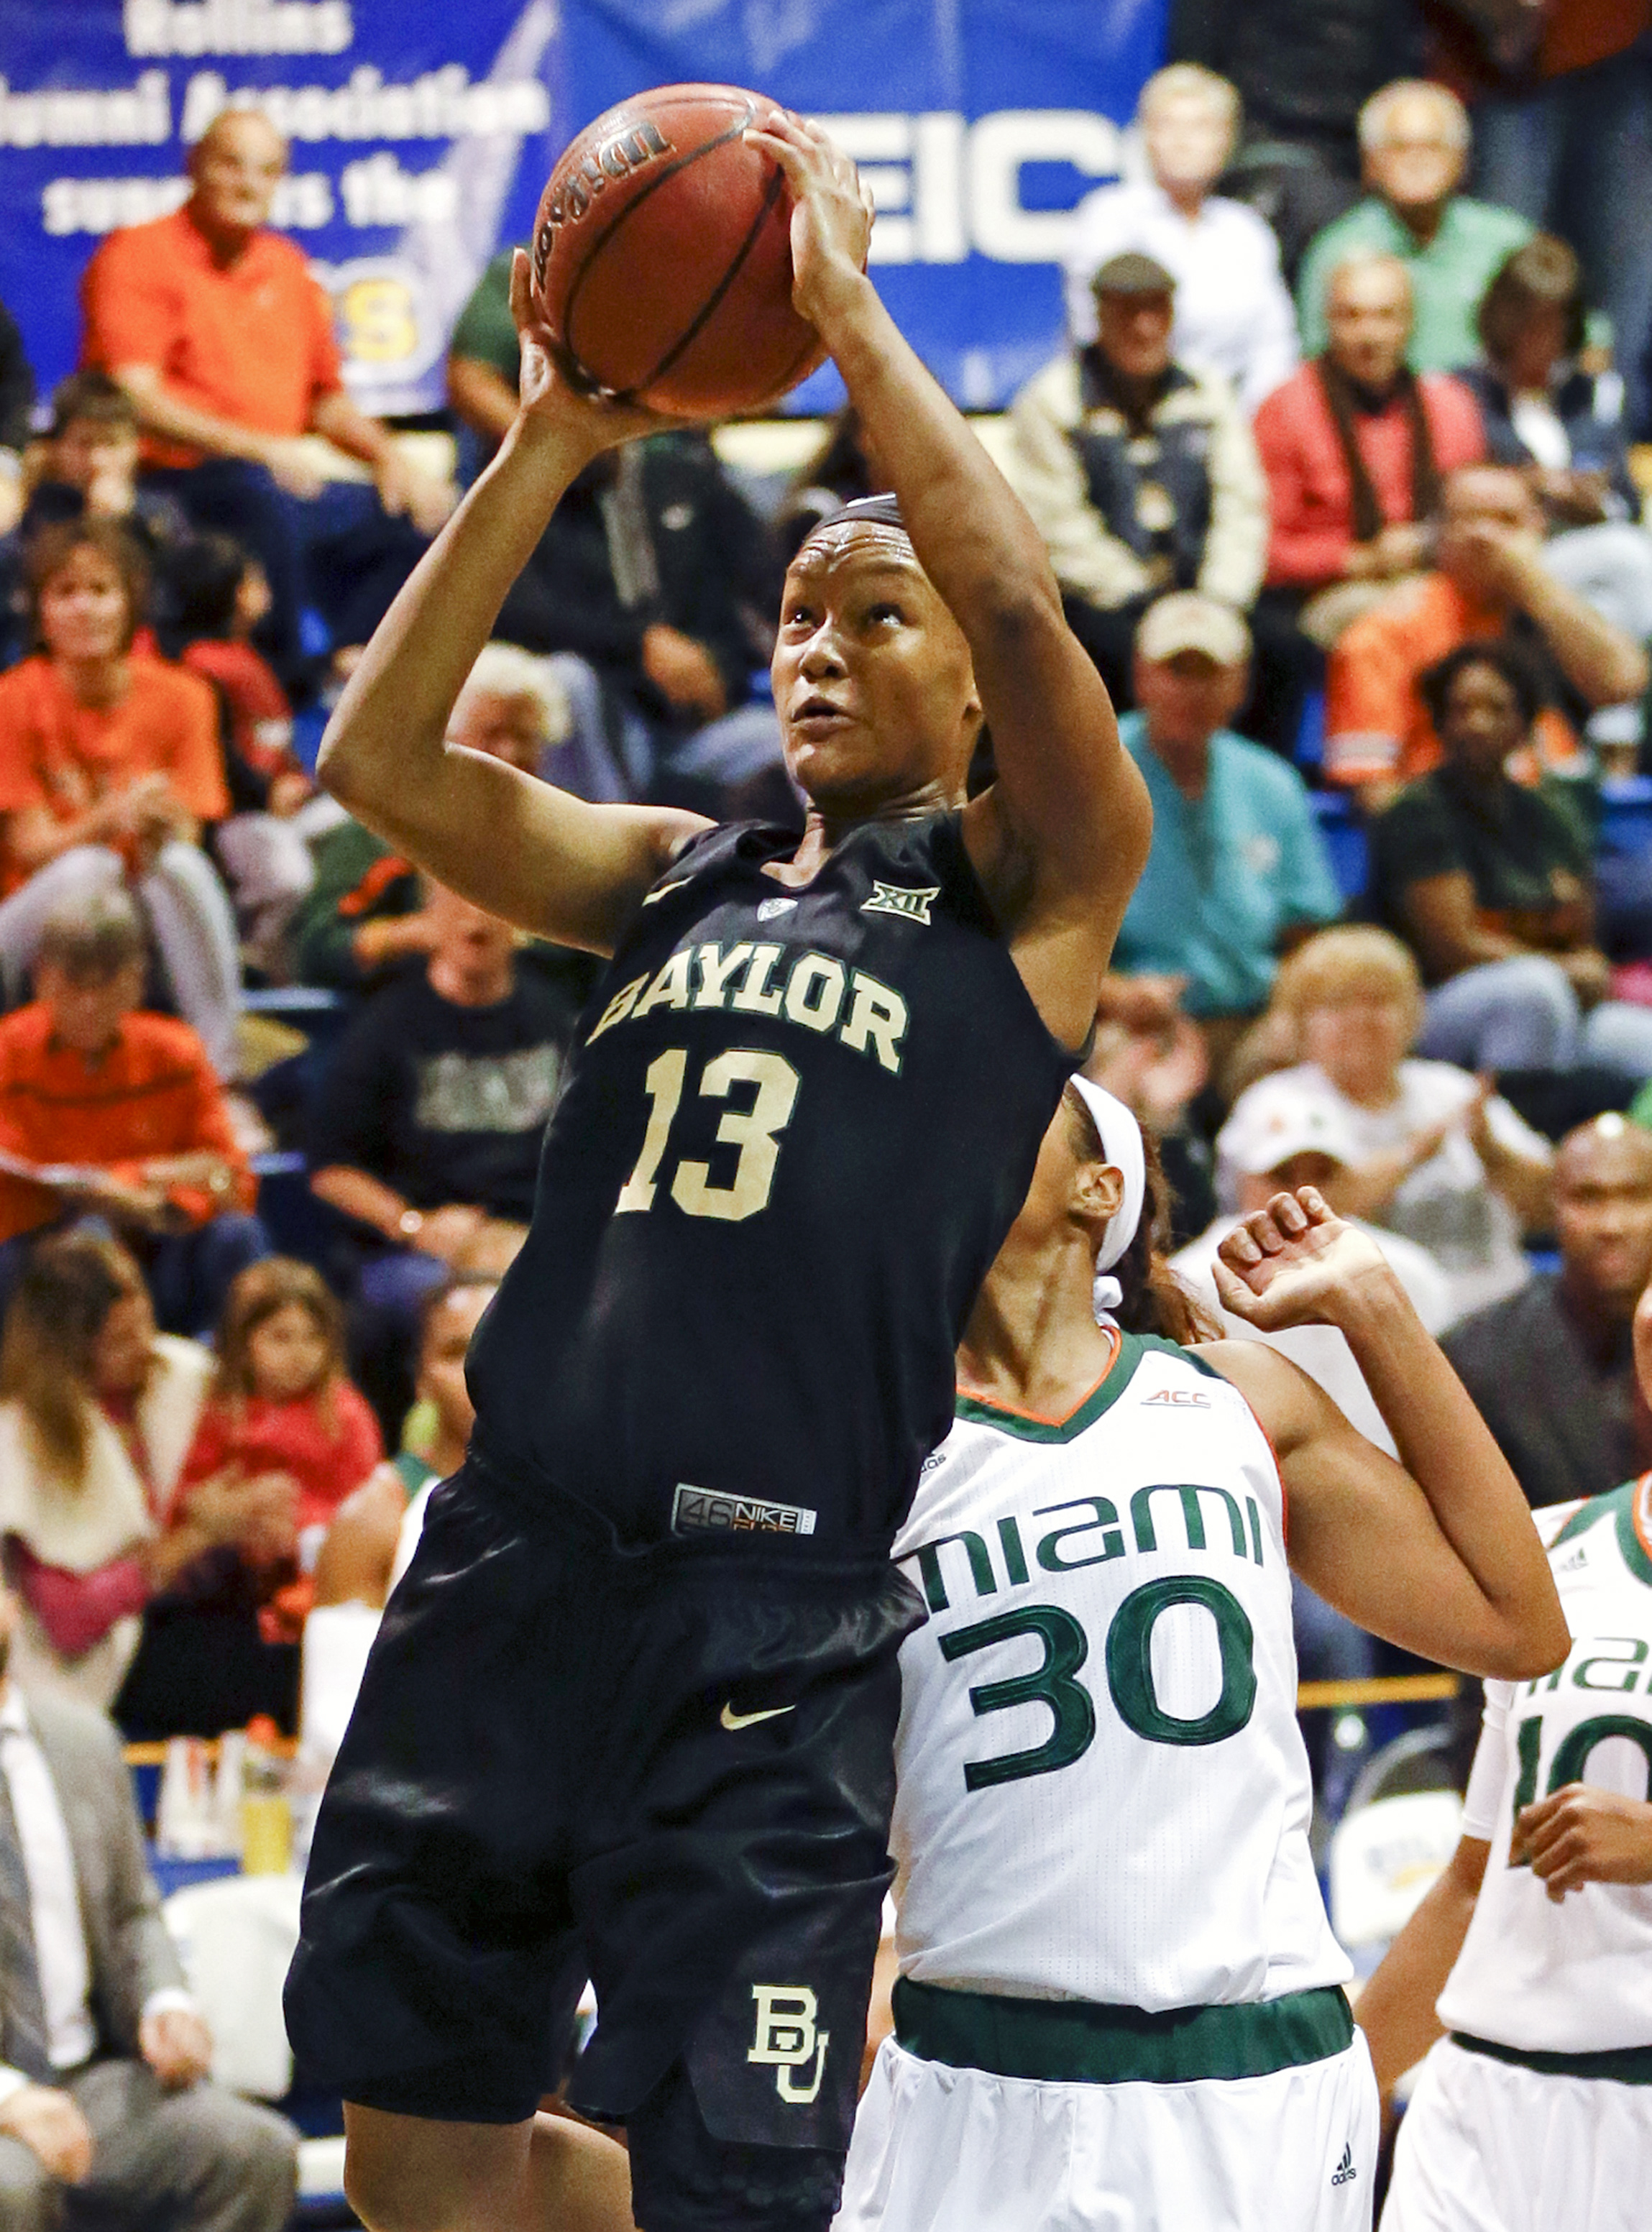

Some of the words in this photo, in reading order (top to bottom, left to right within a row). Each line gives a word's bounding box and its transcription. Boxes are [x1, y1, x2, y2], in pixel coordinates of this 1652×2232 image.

[794, 110, 1150, 265] EIC
[584, 940, 910, 1076] BAYLOR
[613, 1047, 802, 1222] 13
[1146, 1390, 1211, 1407] ACC
[684, 1497, 732, 1528] 46
[735, 1502, 796, 1529] NIKE
[937, 1576, 1257, 1791] 30
[746, 1985, 830, 2104] BU
